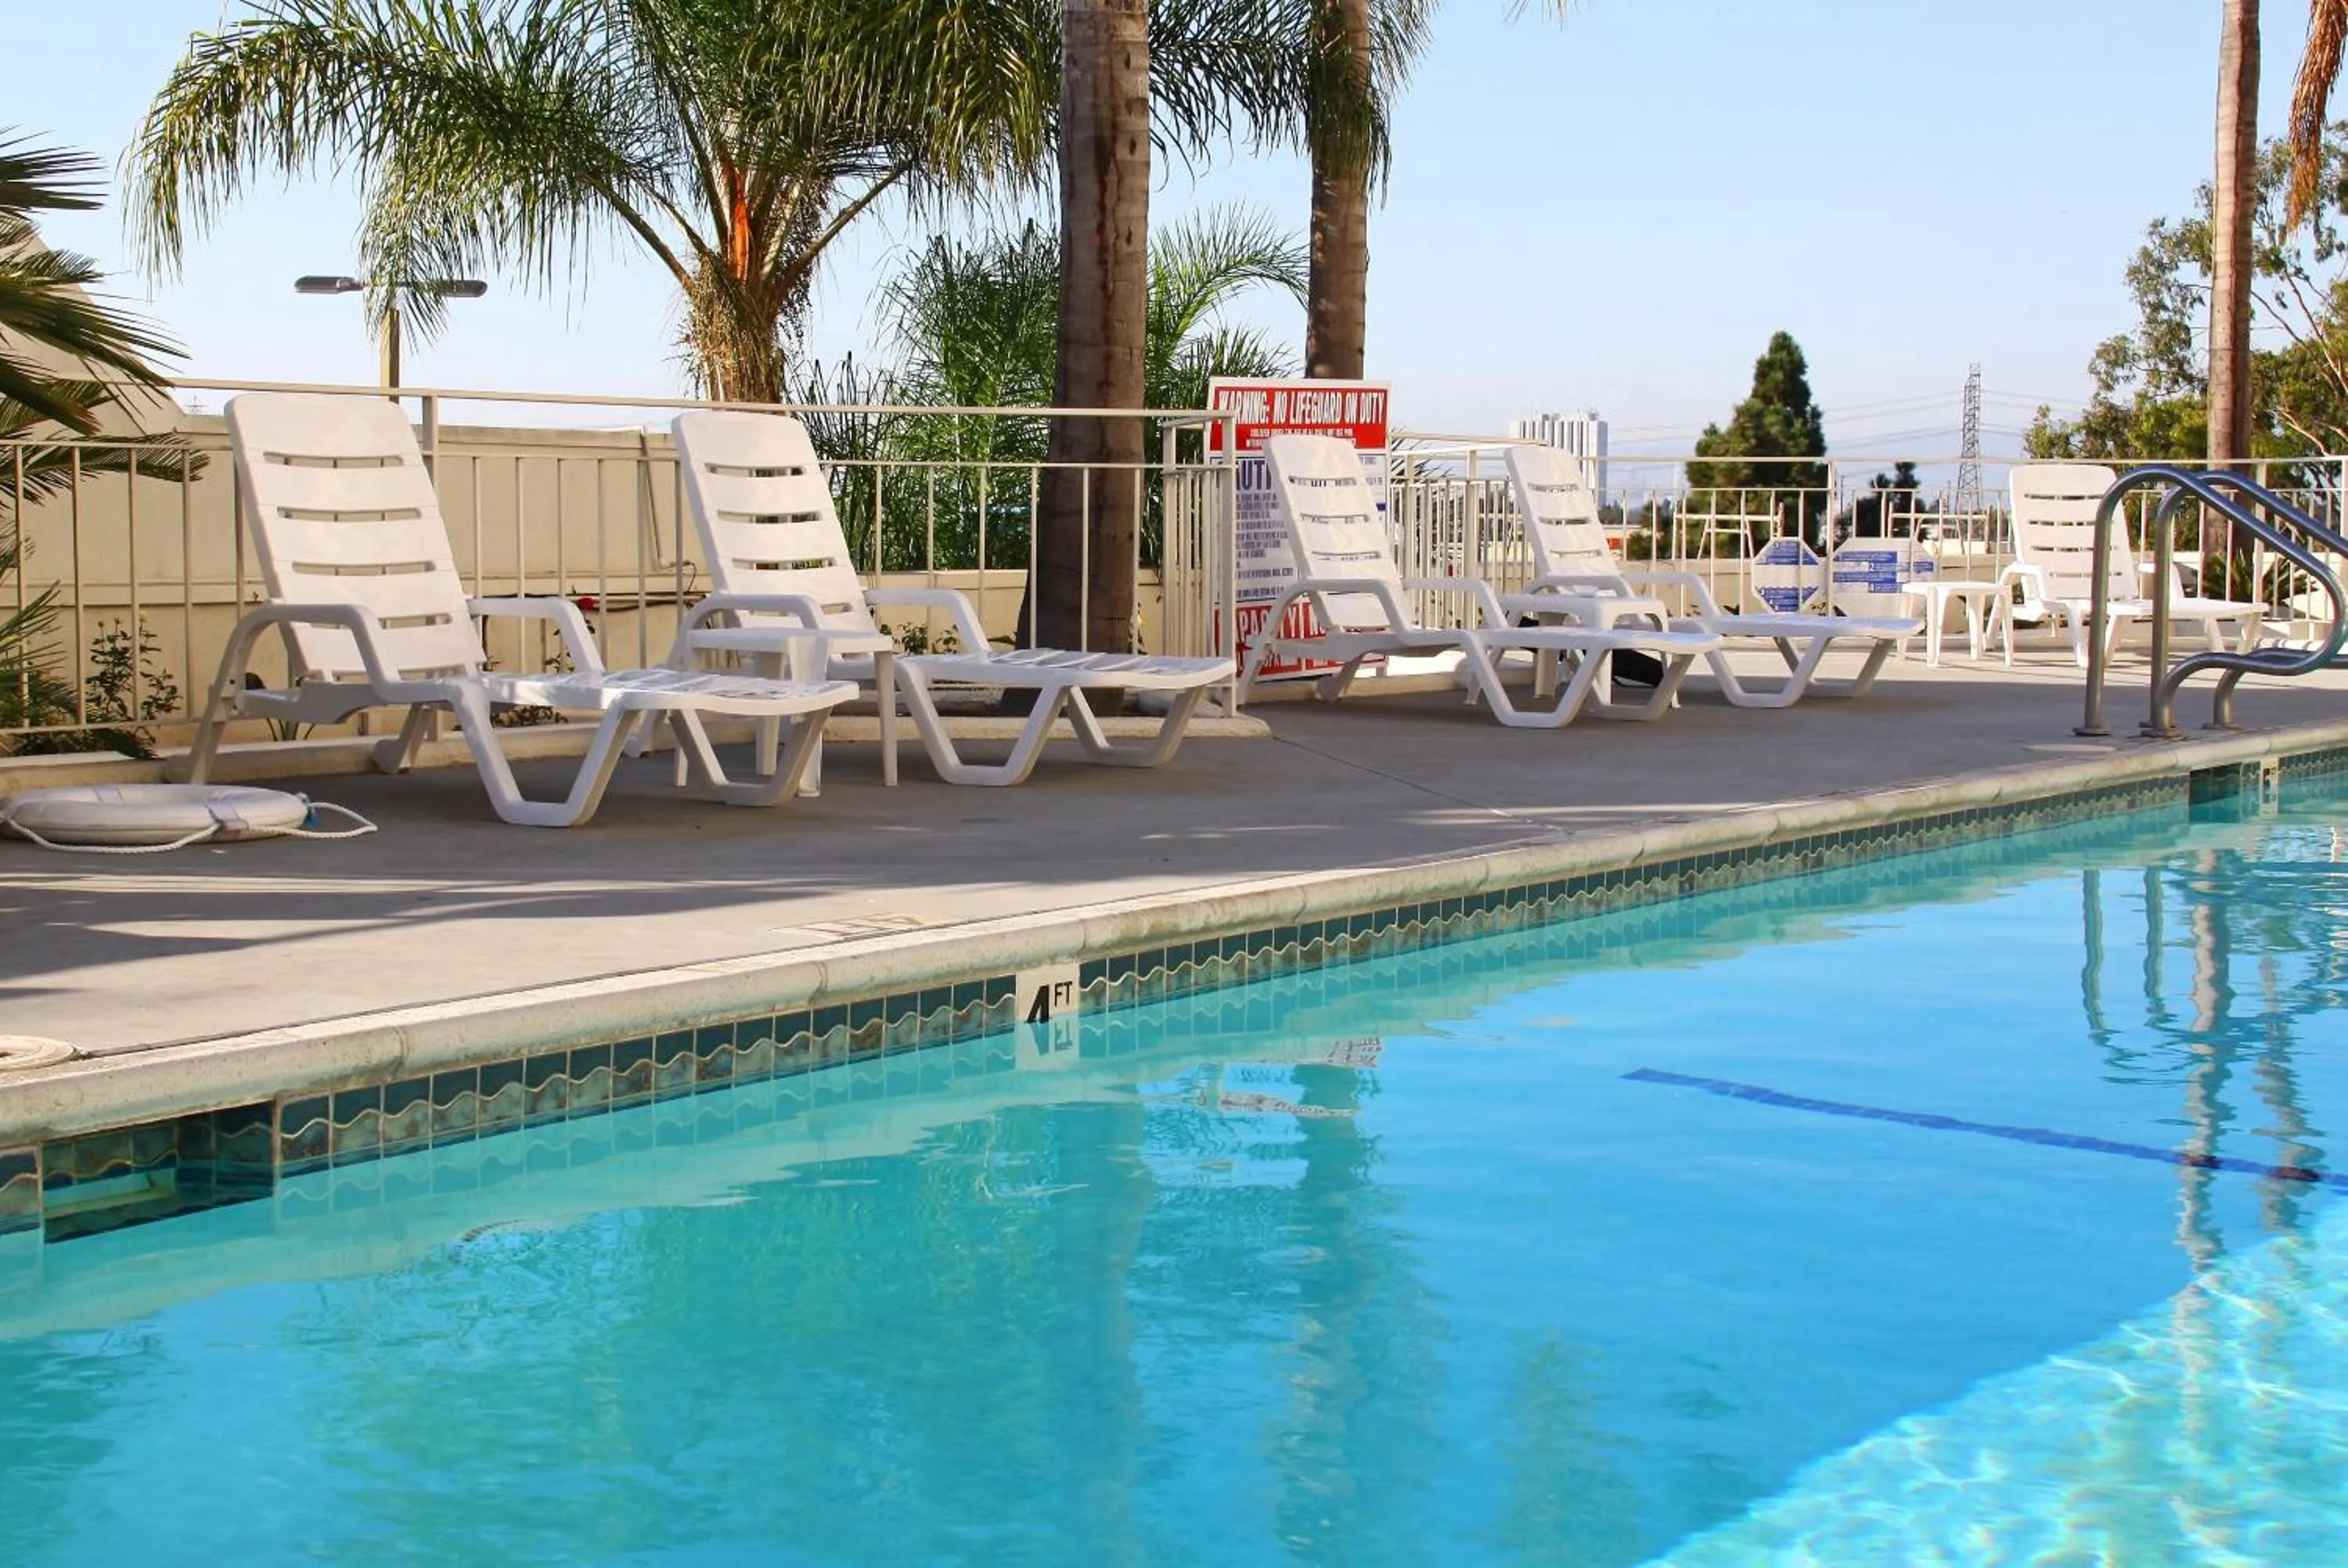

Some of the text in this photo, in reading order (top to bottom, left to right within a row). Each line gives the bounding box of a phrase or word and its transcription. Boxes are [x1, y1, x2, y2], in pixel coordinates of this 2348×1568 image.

[1273, 391, 1287, 424] NO
[1290, 391, 1342, 425] LIFEGUARD
[1345, 392, 1358, 425] ON
[1359, 392, 1385, 425] DUTY
[1053, 981, 1073, 1007] FT
